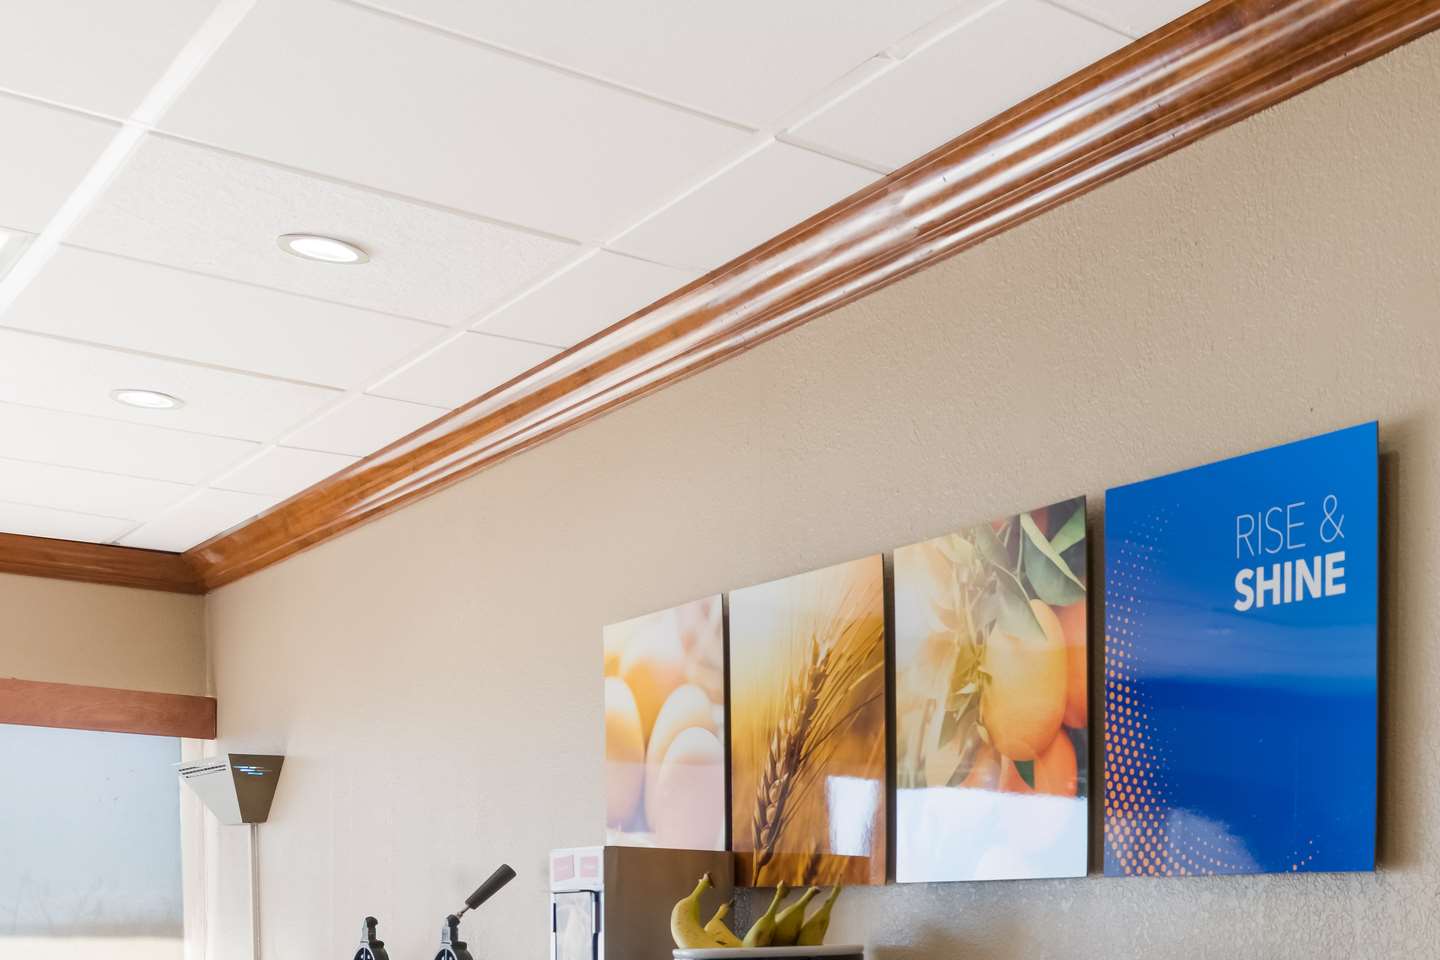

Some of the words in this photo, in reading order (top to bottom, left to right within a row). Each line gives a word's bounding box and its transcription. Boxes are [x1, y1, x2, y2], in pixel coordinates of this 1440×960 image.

[1236, 502, 1306, 559] RISE
[1320, 494, 1345, 543] &
[1234, 551, 1346, 612] SHINE
